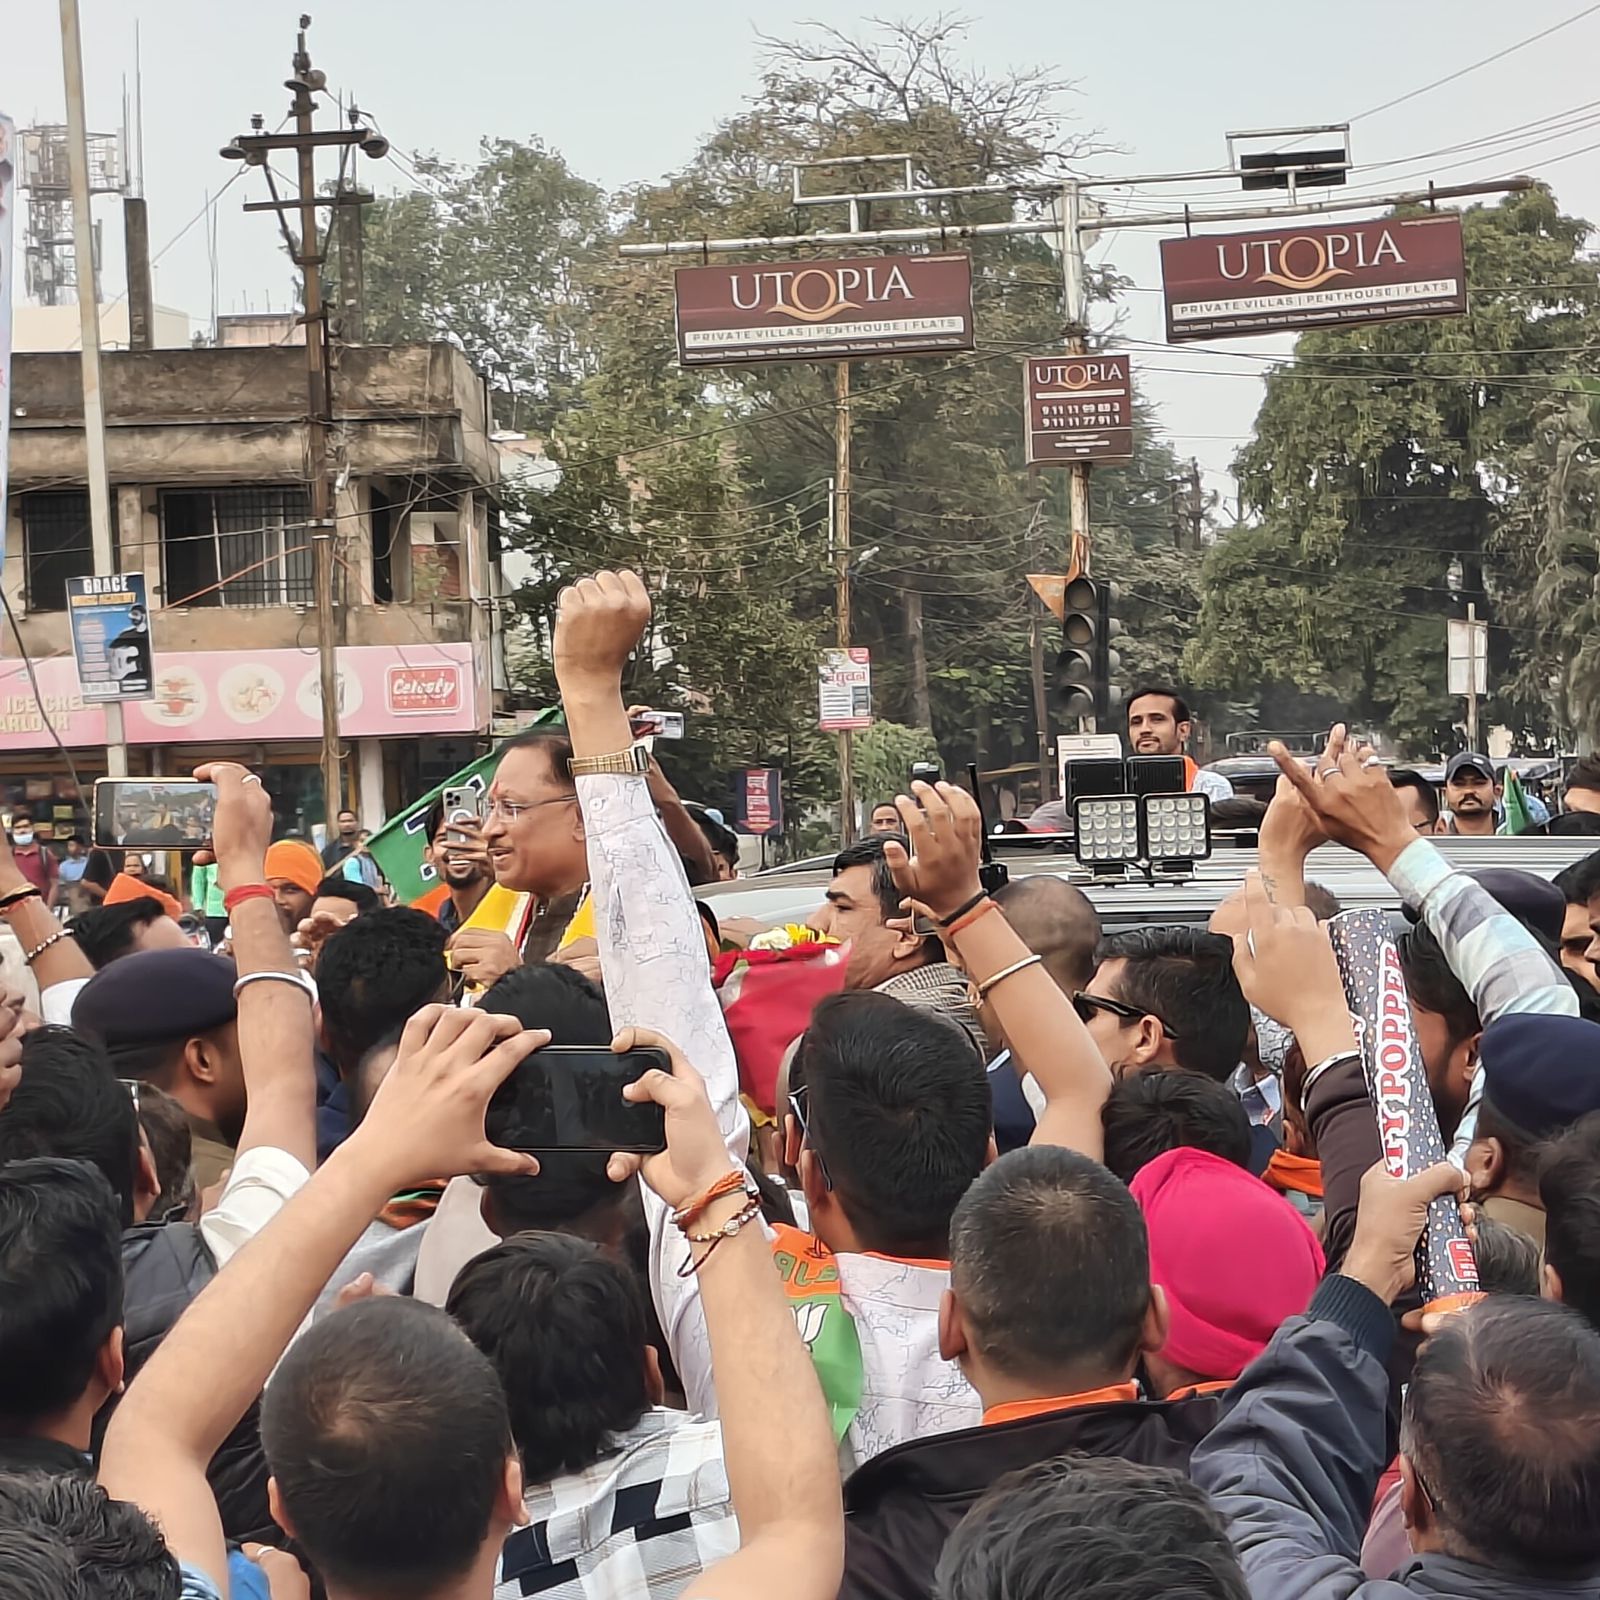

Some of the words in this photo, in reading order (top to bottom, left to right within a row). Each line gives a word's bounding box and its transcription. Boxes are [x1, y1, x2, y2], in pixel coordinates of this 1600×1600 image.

[1217, 229, 1406, 282] UTOPIA
[729, 265, 915, 314] UTOPIA
[1181, 302, 1240, 314] PRIVATE
[1244, 297, 1293, 308] VILLAS
[1306, 287, 1391, 303] PENTHOUSE
[1405, 282, 1449, 294] FLATS
[692, 330, 751, 341] PRIVATE
[756, 327, 803, 338] VILLAS
[816, 322, 900, 335] PENTHOUSE
[912, 319, 956, 329] FLATS
[1035, 363, 1123, 386] UTOPIA
